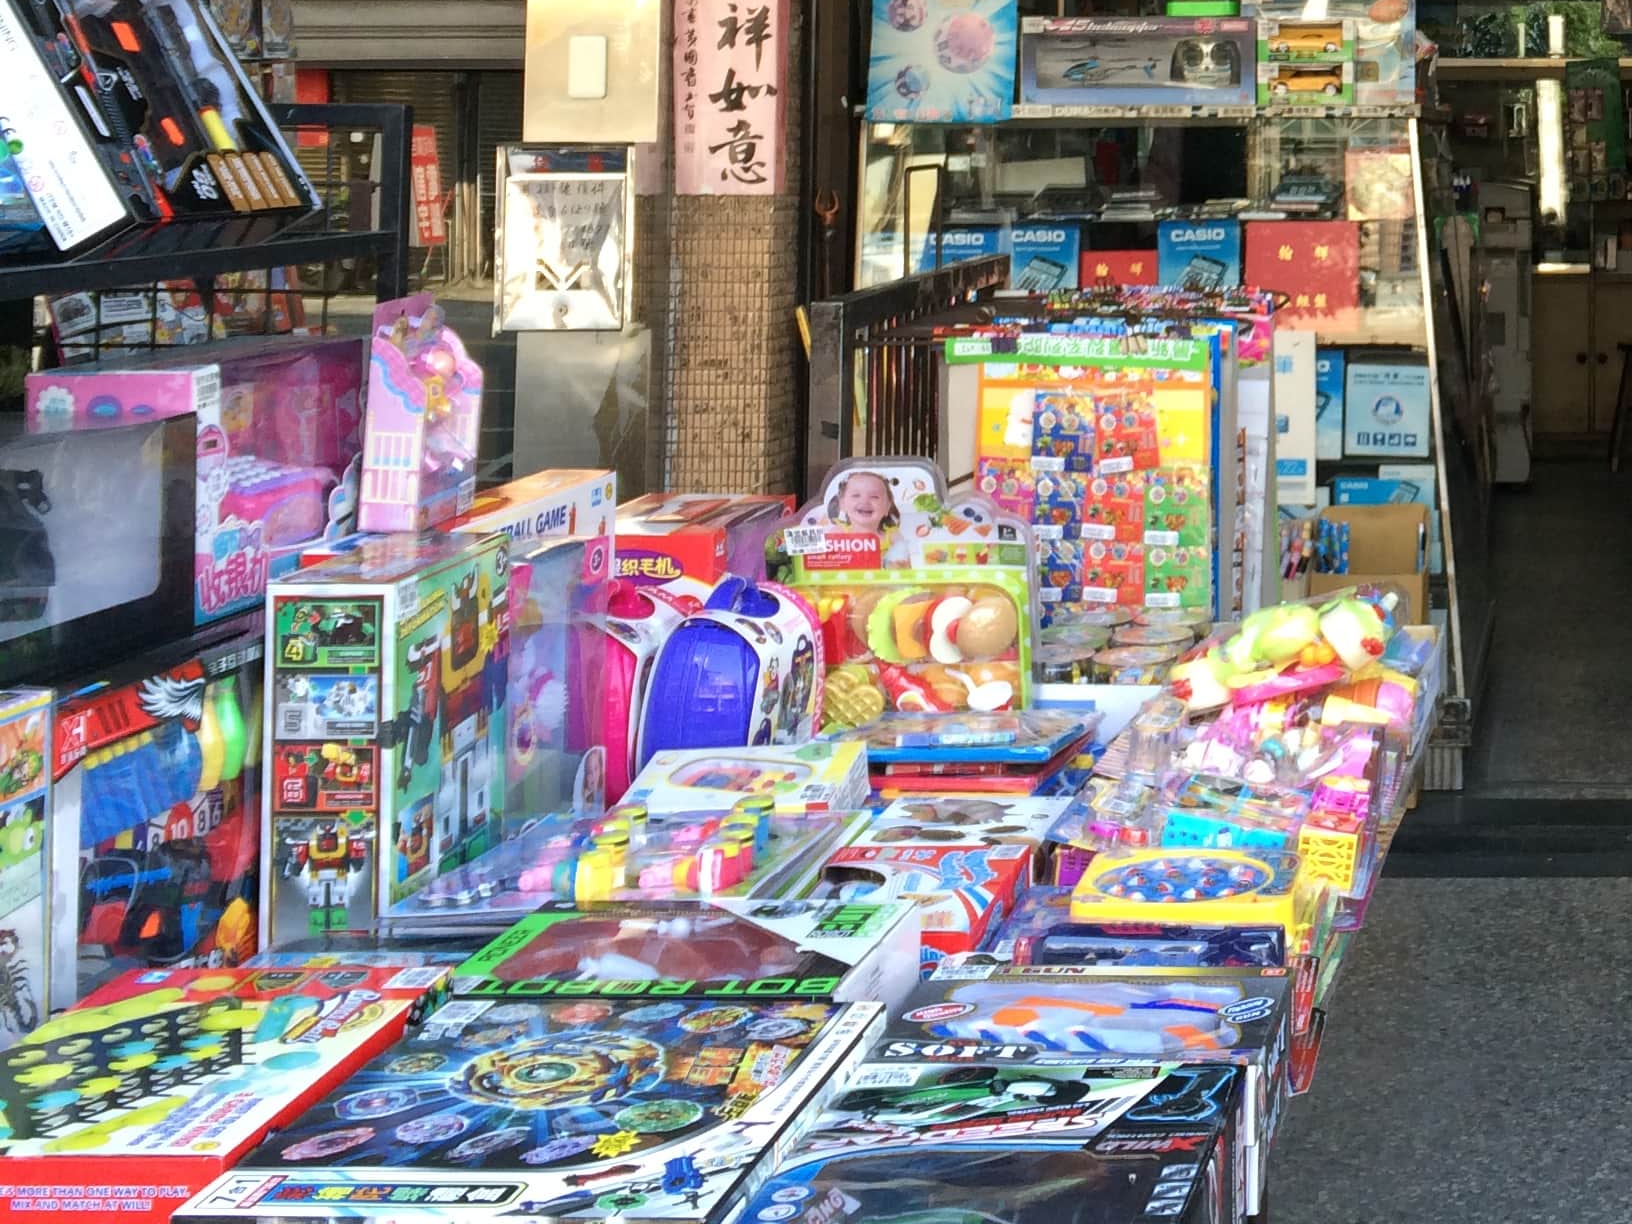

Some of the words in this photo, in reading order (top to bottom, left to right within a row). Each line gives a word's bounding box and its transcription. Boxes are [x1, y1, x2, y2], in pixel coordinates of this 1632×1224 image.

[1011, 229, 1066, 243] CASIO
[1170, 228, 1225, 243] CASIO
[536, 505, 568, 535] GAME
[825, 538, 877, 552] SHION
[284, 639, 304, 662] 4
[467, 976, 700, 995] ROBOT
[704, 976, 842, 995] BOT
[884, 1041, 1027, 1059] SOFT
[17, 1186, 49, 1197] MORE
[52, 1186, 83, 1197] THAN
[86, 1186, 110, 1197] ONE
[113, 1186, 138, 1197] WAY
[141, 1186, 156, 1197] TO
[12, 1199, 31, 1210] MIX
[36, 1199, 57, 1210] AND
[62, 1199, 100, 1210] MATCH
[103, 1199, 119, 1210] AT
